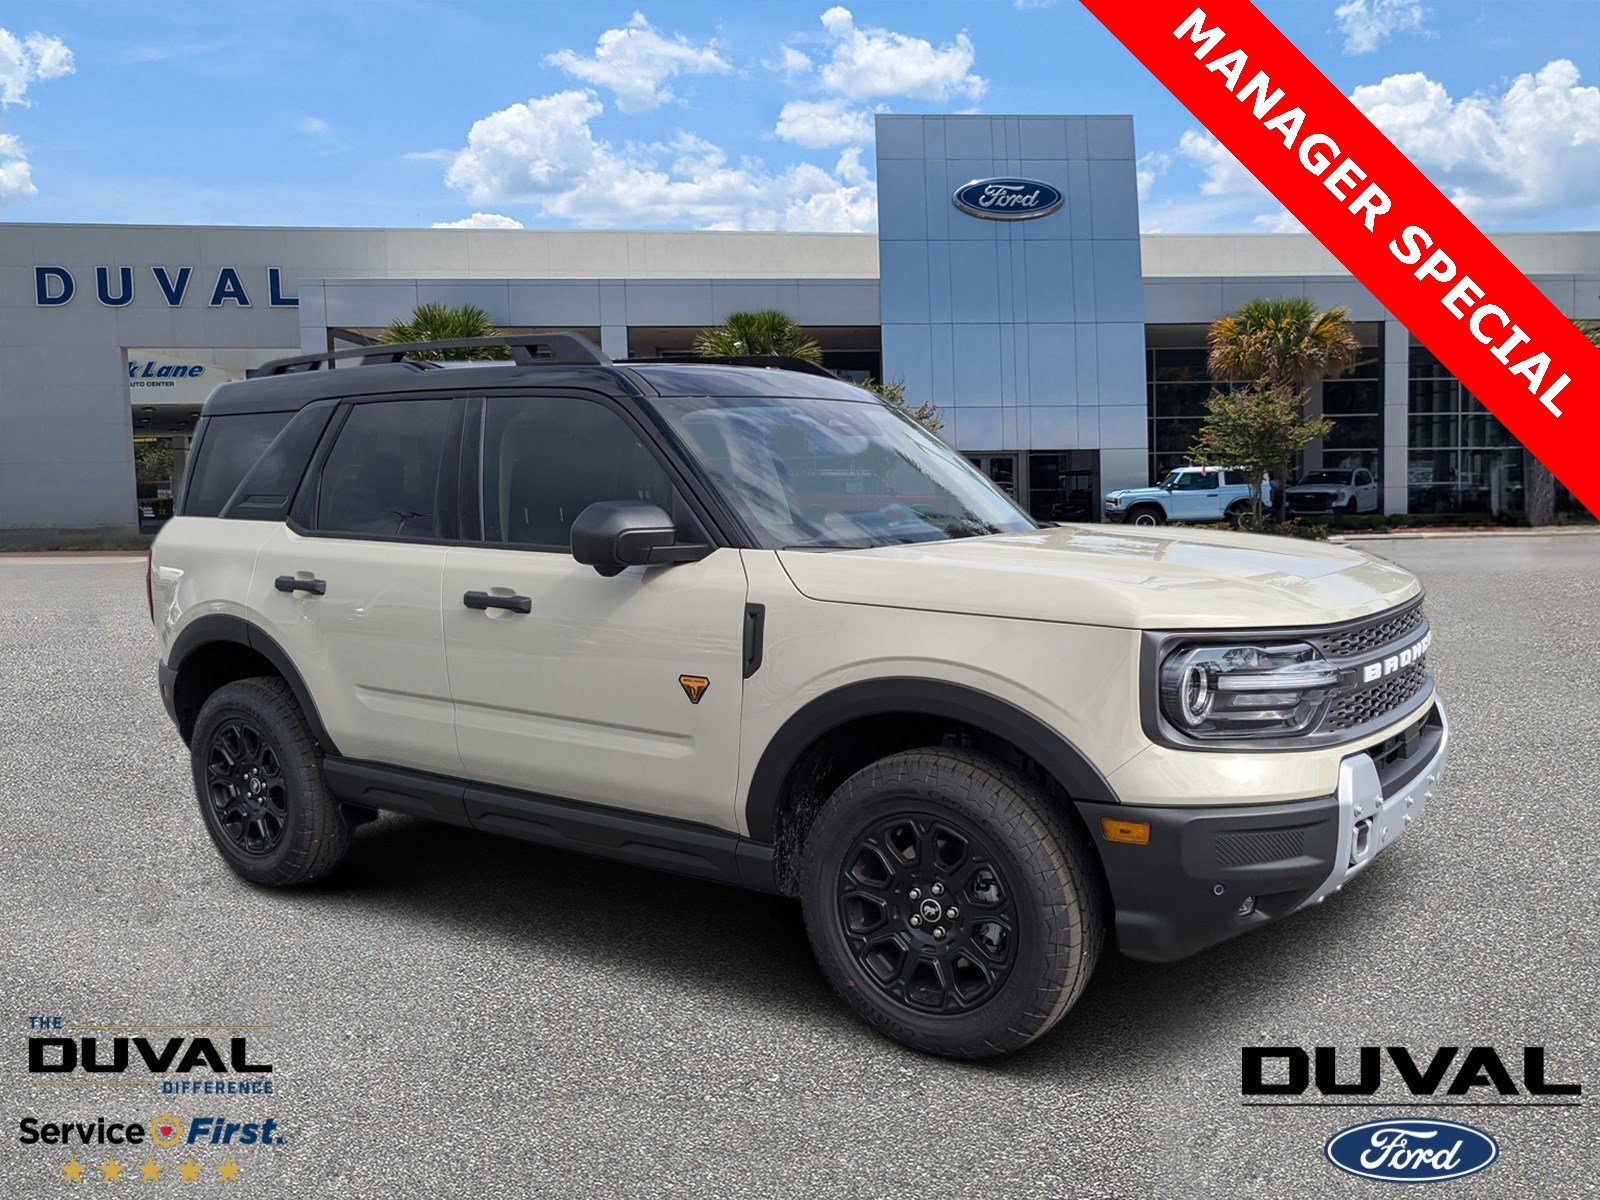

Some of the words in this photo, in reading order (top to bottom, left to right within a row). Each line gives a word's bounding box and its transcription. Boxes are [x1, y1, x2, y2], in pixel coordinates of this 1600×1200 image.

[978, 184, 1041, 207] Ford
[33, 265, 300, 308] DUVAL
[141, 361, 205, 378] Lane
